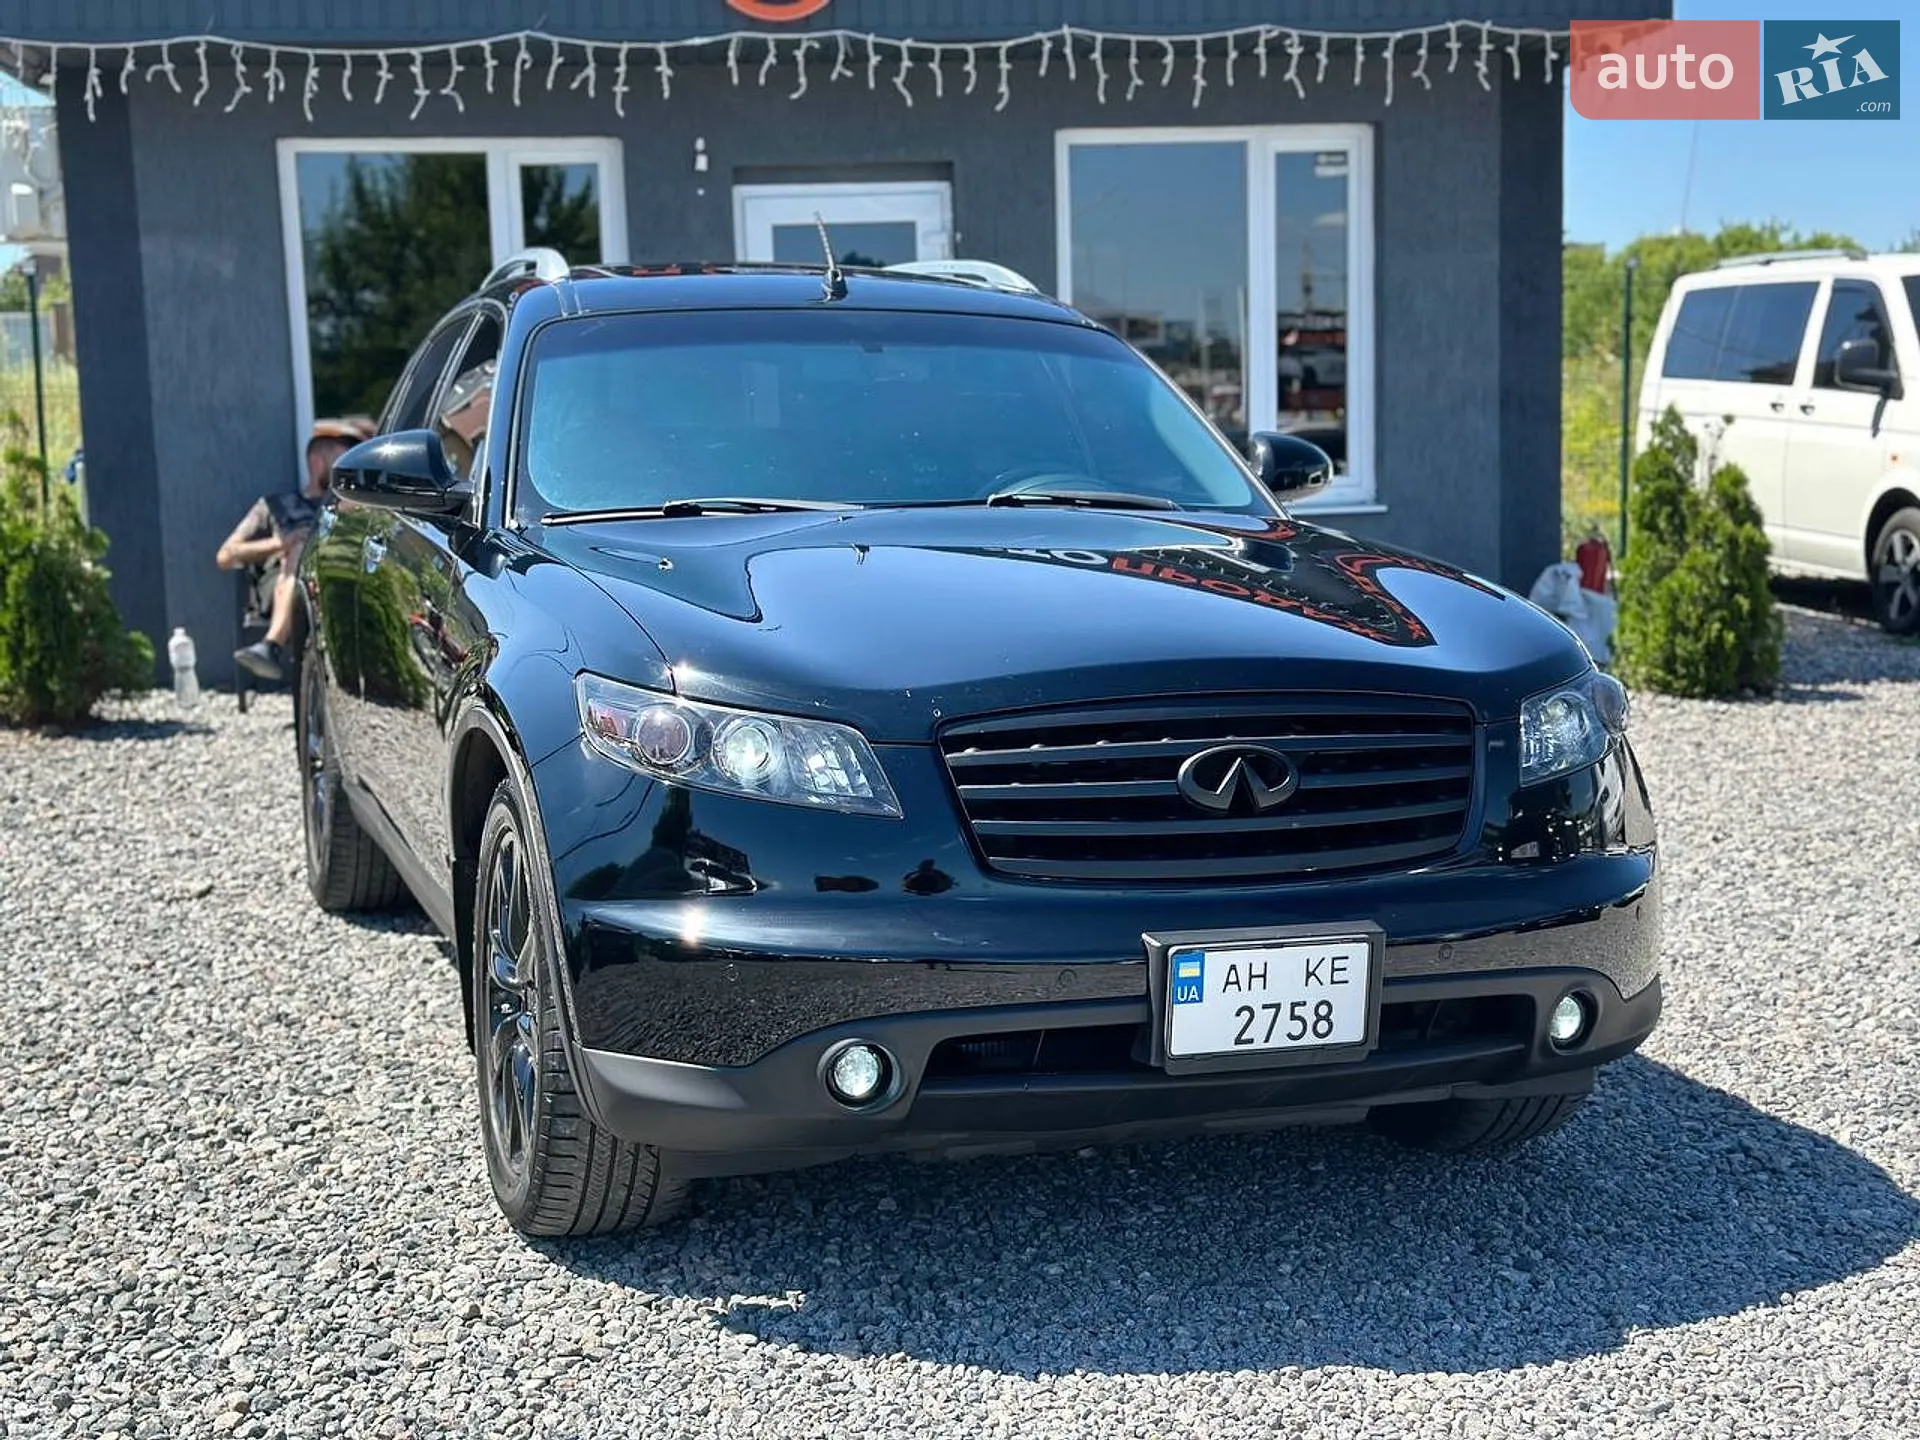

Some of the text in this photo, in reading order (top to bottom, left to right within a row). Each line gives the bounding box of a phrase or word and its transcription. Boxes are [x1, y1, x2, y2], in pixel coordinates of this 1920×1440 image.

[1177, 985, 1200, 1002] UA
[1222, 955, 1350, 994] AH KE
[1233, 999, 1334, 1046] 2758
